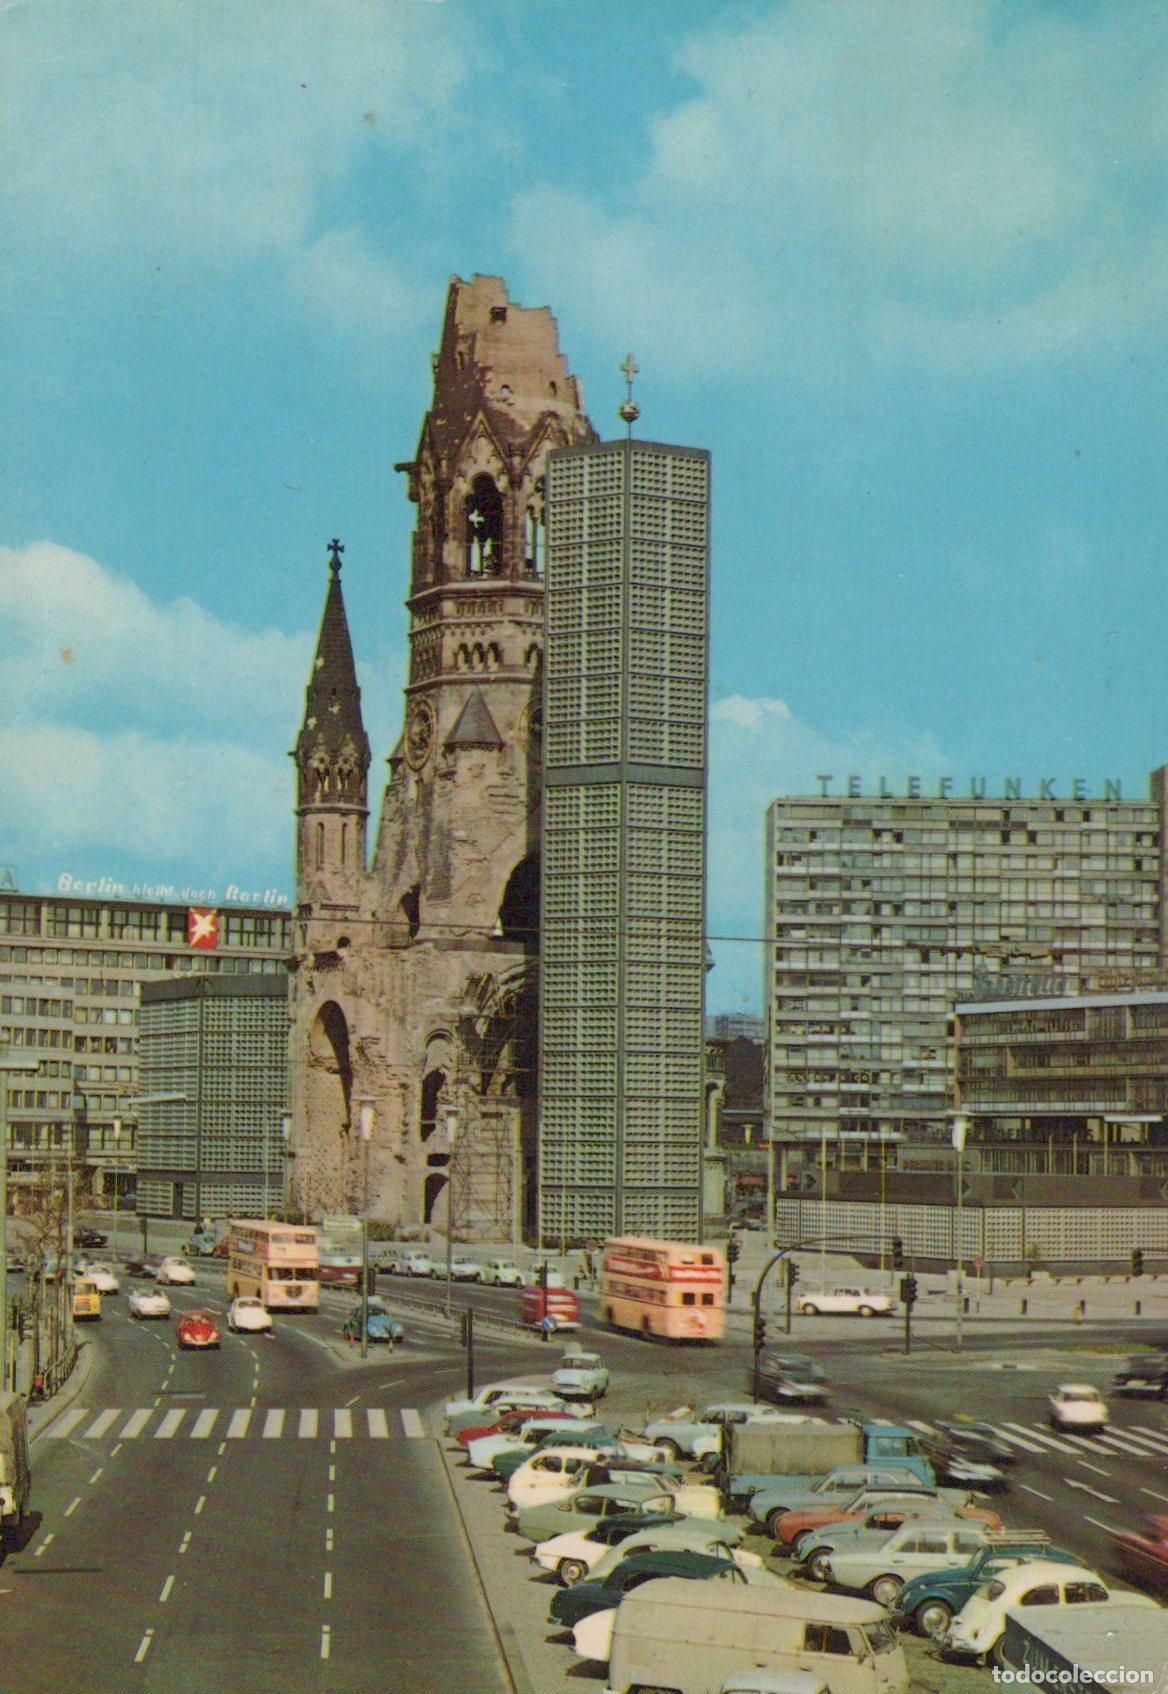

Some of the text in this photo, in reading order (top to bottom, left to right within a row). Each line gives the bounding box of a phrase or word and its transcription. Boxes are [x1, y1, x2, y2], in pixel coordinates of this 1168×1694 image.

[815, 774, 1122, 800] TELEFUNKEN
[57, 872, 124, 894] Berlin
[225, 884, 288, 905] Berlin
